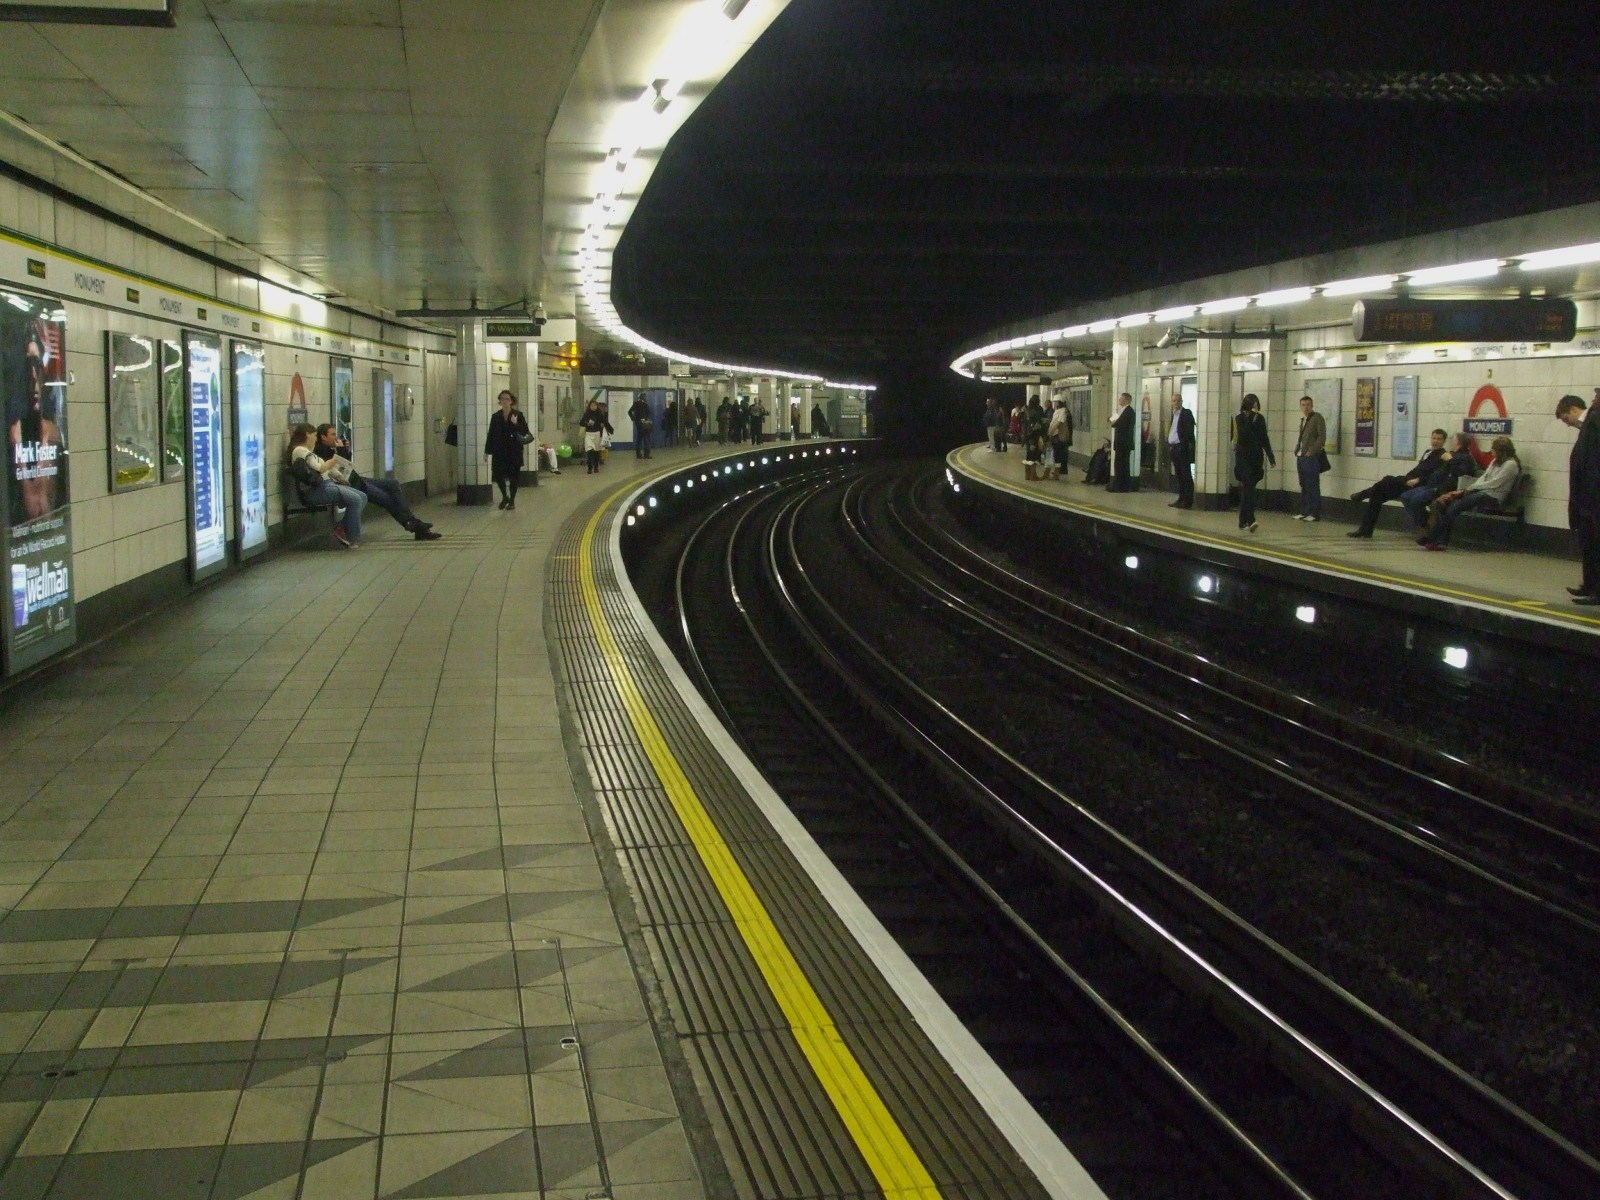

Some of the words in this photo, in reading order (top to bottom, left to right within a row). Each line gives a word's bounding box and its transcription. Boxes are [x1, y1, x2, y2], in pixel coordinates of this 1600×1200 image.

[75, 272, 105, 294] MONUMENT
[497, 326, 513, 336] Way
[515, 326, 530, 335] out
[1469, 422, 1505, 432] MONUMENT
[15, 441, 35, 463] Mark
[36, 441, 57, 461] Foster
[37, 465, 58, 479] Champion
[27, 561, 68, 604] wellman
